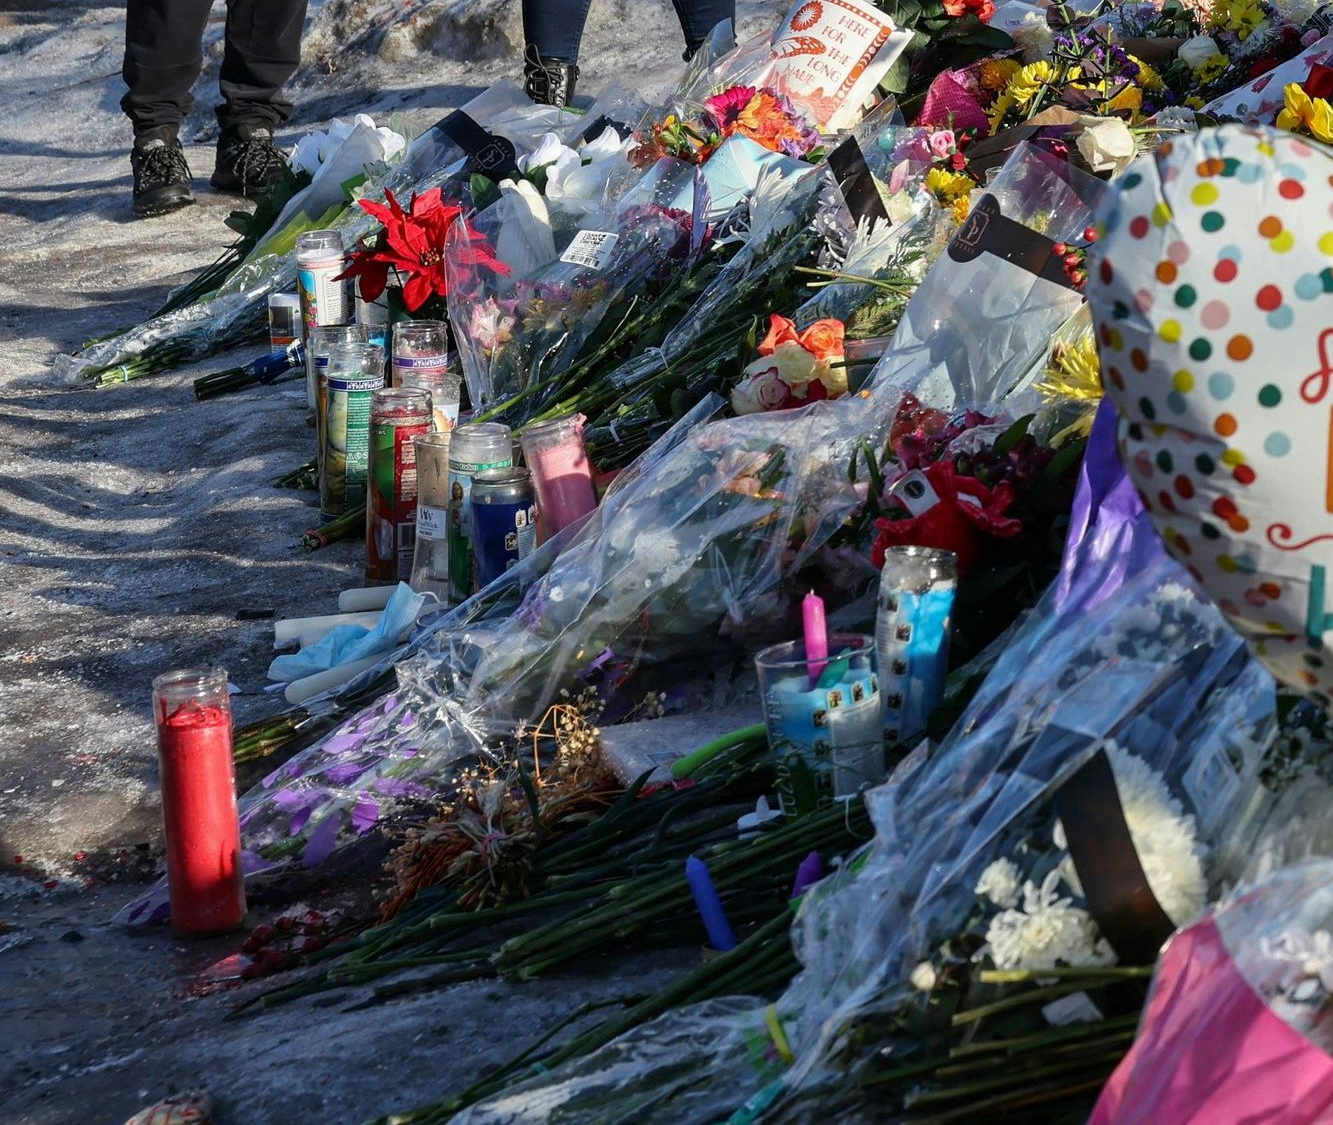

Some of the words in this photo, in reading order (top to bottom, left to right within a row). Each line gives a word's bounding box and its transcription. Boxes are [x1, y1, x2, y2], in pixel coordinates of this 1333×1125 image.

[821, 25, 847, 45] FOR
[838, 14, 872, 38] HERE
[827, 44, 854, 66] THE
[806, 56, 842, 83] LONG
